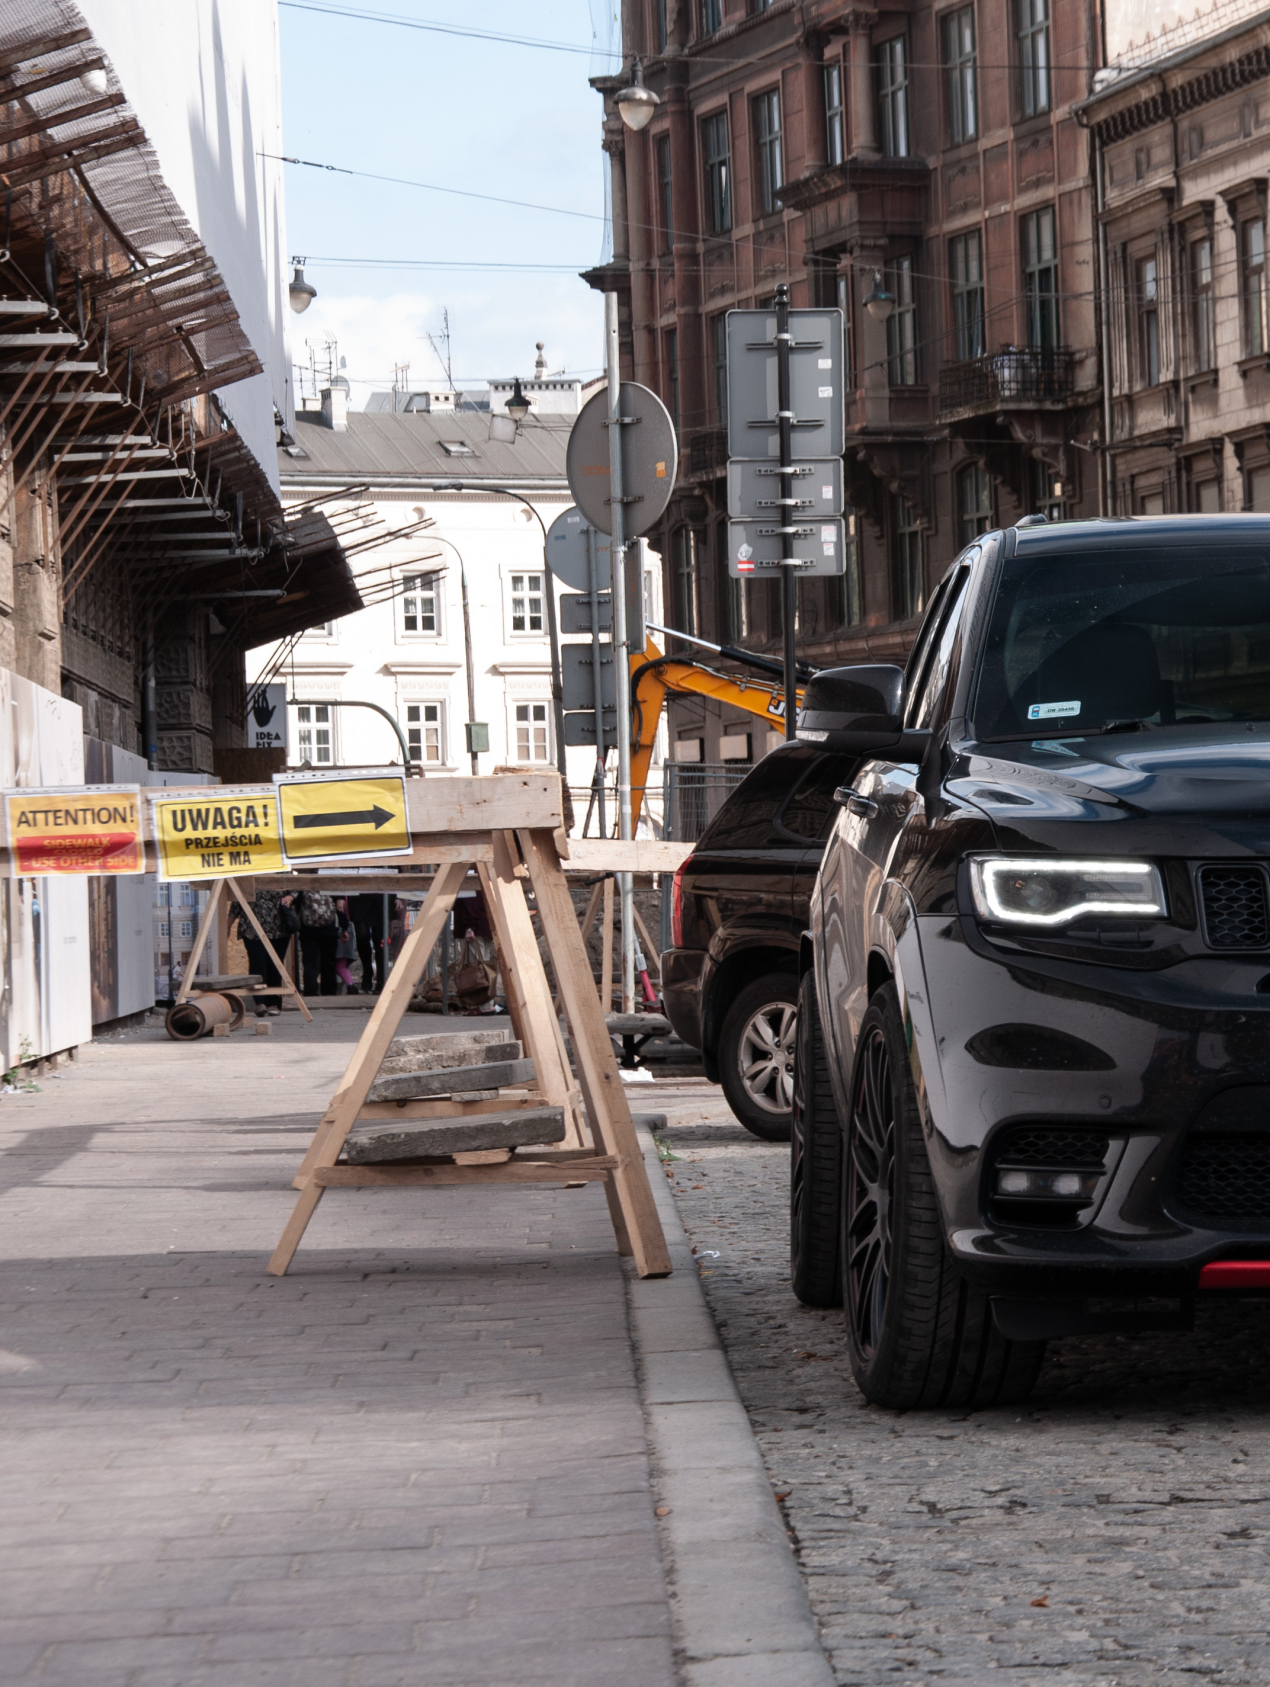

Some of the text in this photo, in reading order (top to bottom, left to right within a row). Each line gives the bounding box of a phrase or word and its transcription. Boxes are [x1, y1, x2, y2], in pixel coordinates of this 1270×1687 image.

[256, 731, 281, 741] IDEA
[17, 805, 135, 828] ATTENTION!
[171, 804, 269, 833] UWAGA!
[43, 836, 111, 850] SIDEWALK
[184, 832, 263, 850] PRZEJŚCIA
[54, 848, 104, 856] CLOSED
[200, 850, 252, 868] NIE MA
[31, 857, 58, 867] USE
[60, 856, 103, 867] OTHER
[106, 855, 136, 866] SIDE
